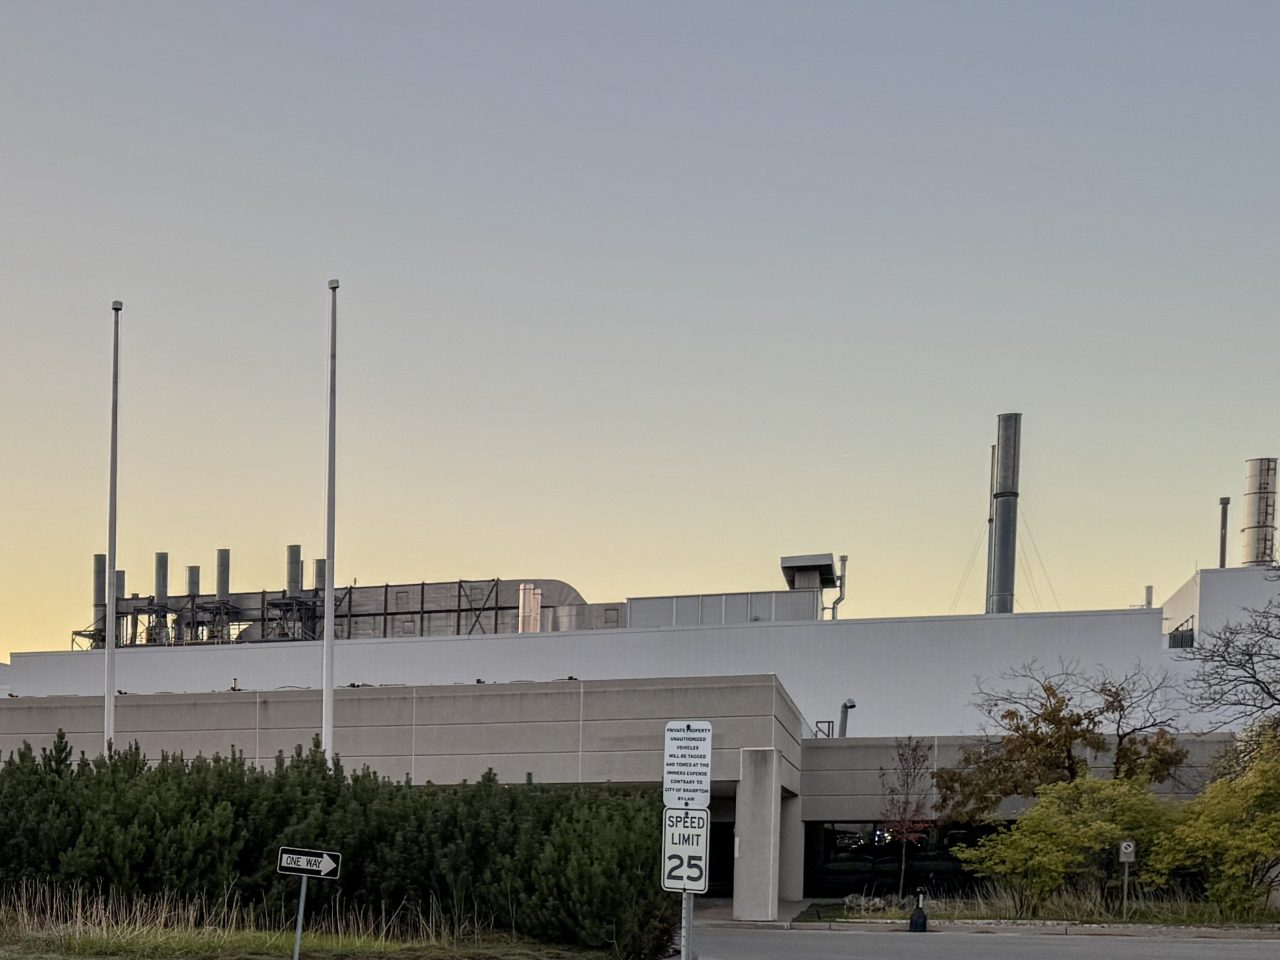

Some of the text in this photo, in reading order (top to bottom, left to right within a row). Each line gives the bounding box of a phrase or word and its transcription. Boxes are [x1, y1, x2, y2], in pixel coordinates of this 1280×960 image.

[667, 815, 705, 829] SPEED
[671, 832, 702, 847] LIMIT
[286, 856, 322, 868] ONE WAY
[666, 854, 704, 882] 25
